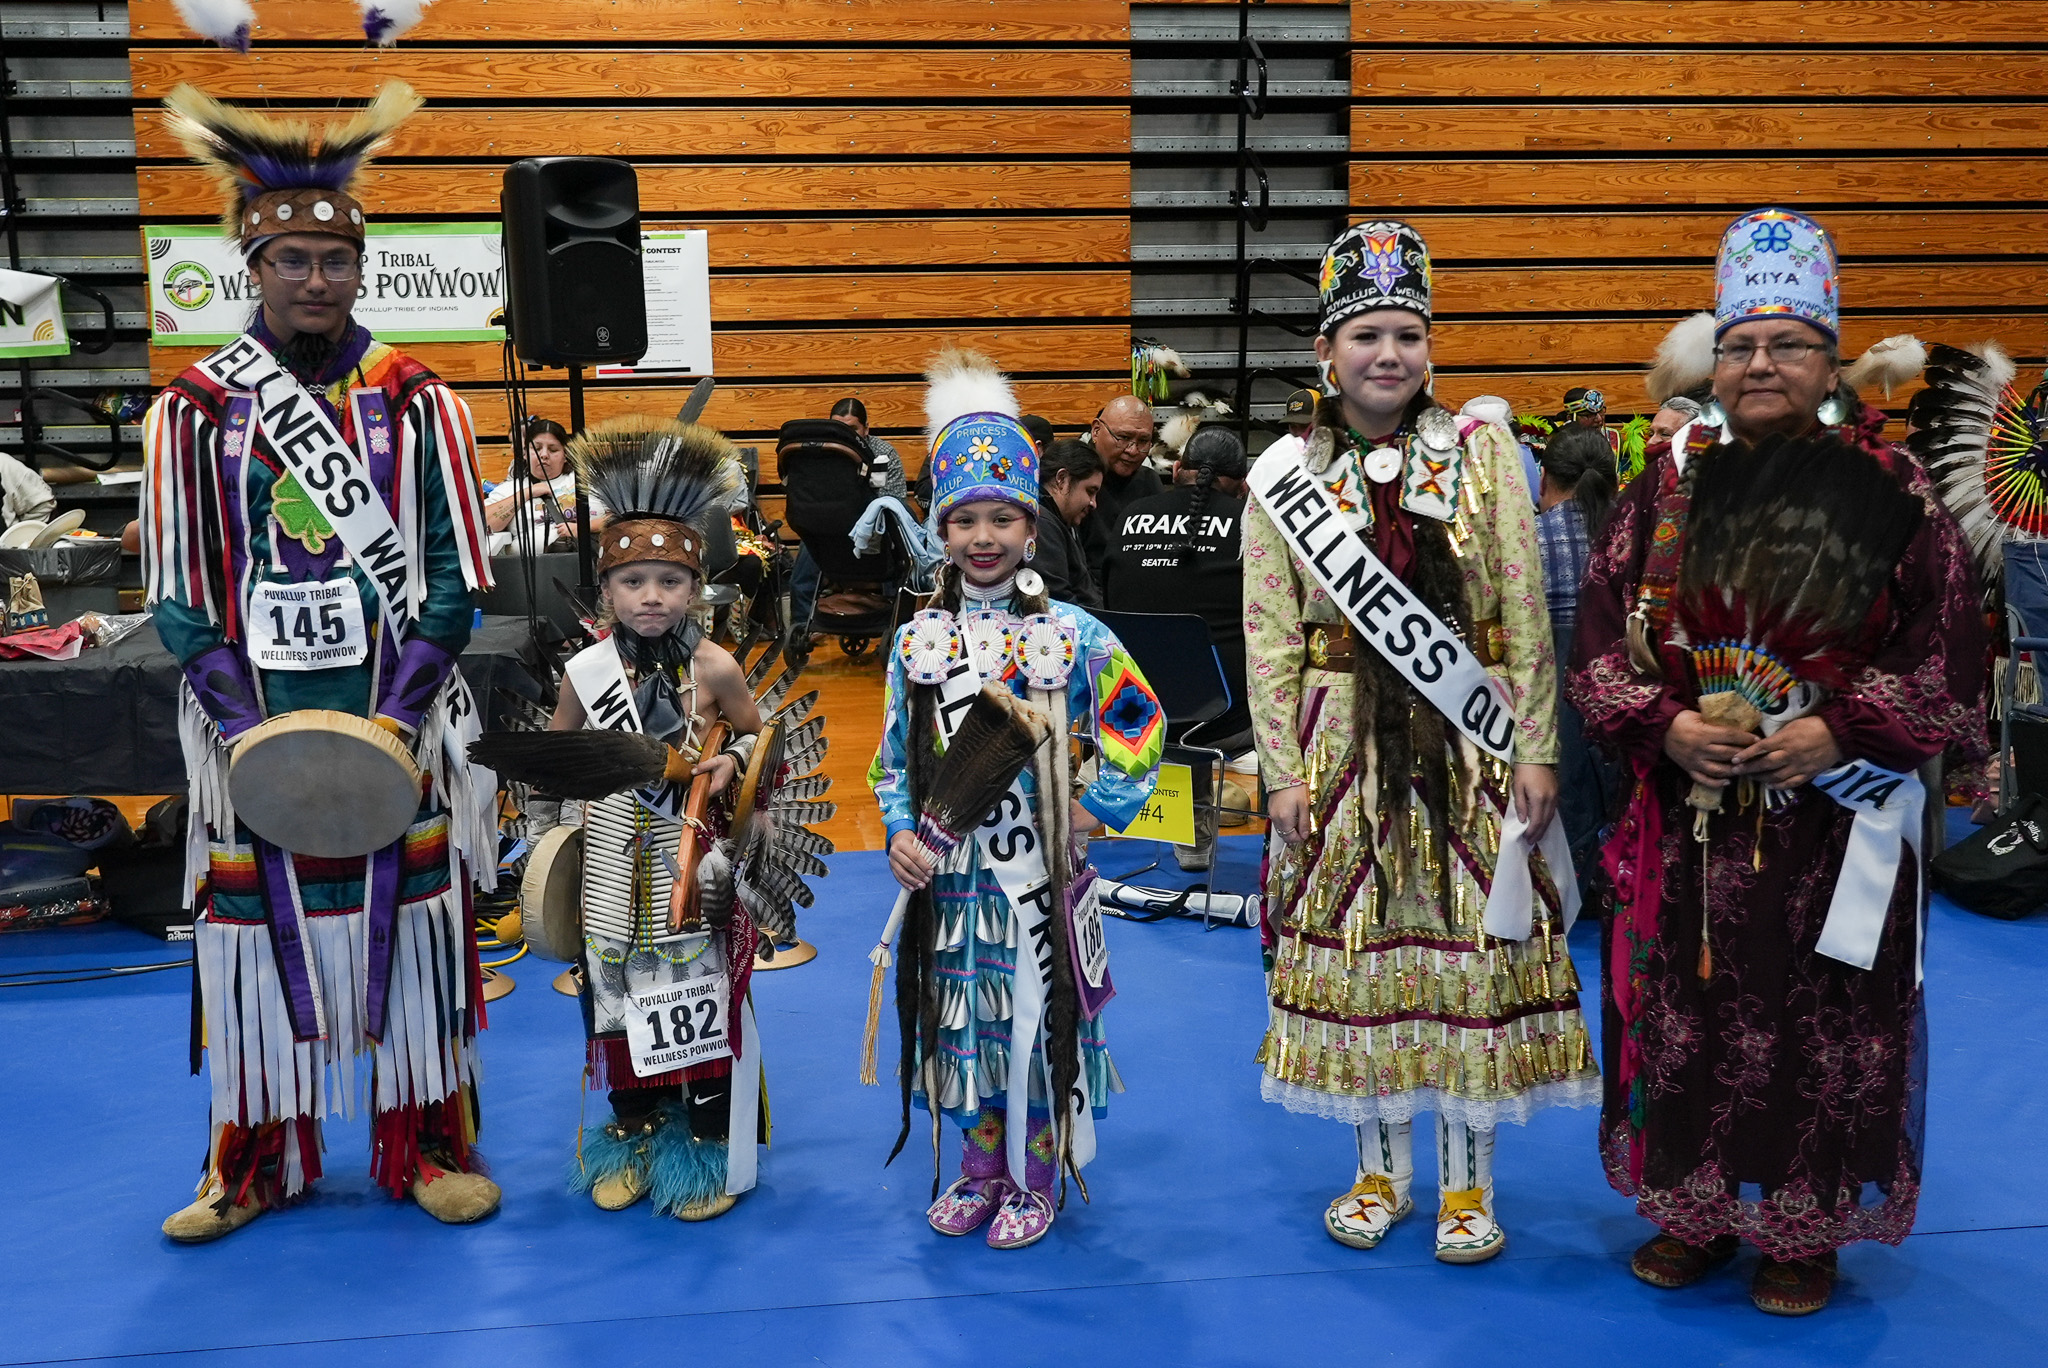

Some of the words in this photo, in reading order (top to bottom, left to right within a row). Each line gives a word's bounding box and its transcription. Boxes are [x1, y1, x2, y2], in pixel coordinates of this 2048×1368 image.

[378, 251, 434, 267] TRIBAL
[375, 266, 503, 299] POWWOW
[1745, 272, 1800, 287] KIYA
[1326, 287, 1377, 315] PUYALLUP
[956, 426, 1008, 439] PRINCESS
[936, 475, 964, 499] ALLUP
[1122, 514, 1233, 538] KRAKEN
[1141, 558, 1179, 567] SEATTLE
[1264, 464, 1458, 684] WELLNESS
[264, 588, 306, 602] PUYALLUP
[309, 586, 343, 601] TRIBAL
[269, 602, 347, 647] 145
[261, 649, 308, 662] WELLNESS
[310, 645, 357, 661] POWWOW
[1150, 787, 1180, 798] ONTEST
[1140, 804, 1164, 824] #4
[1083, 907, 1102, 967] 186
[639, 990, 683, 1008] PUYALLUP
[685, 982, 717, 999] TRIBAL
[646, 998, 722, 1051] 182
[643, 1049, 688, 1066] WELLNESS
